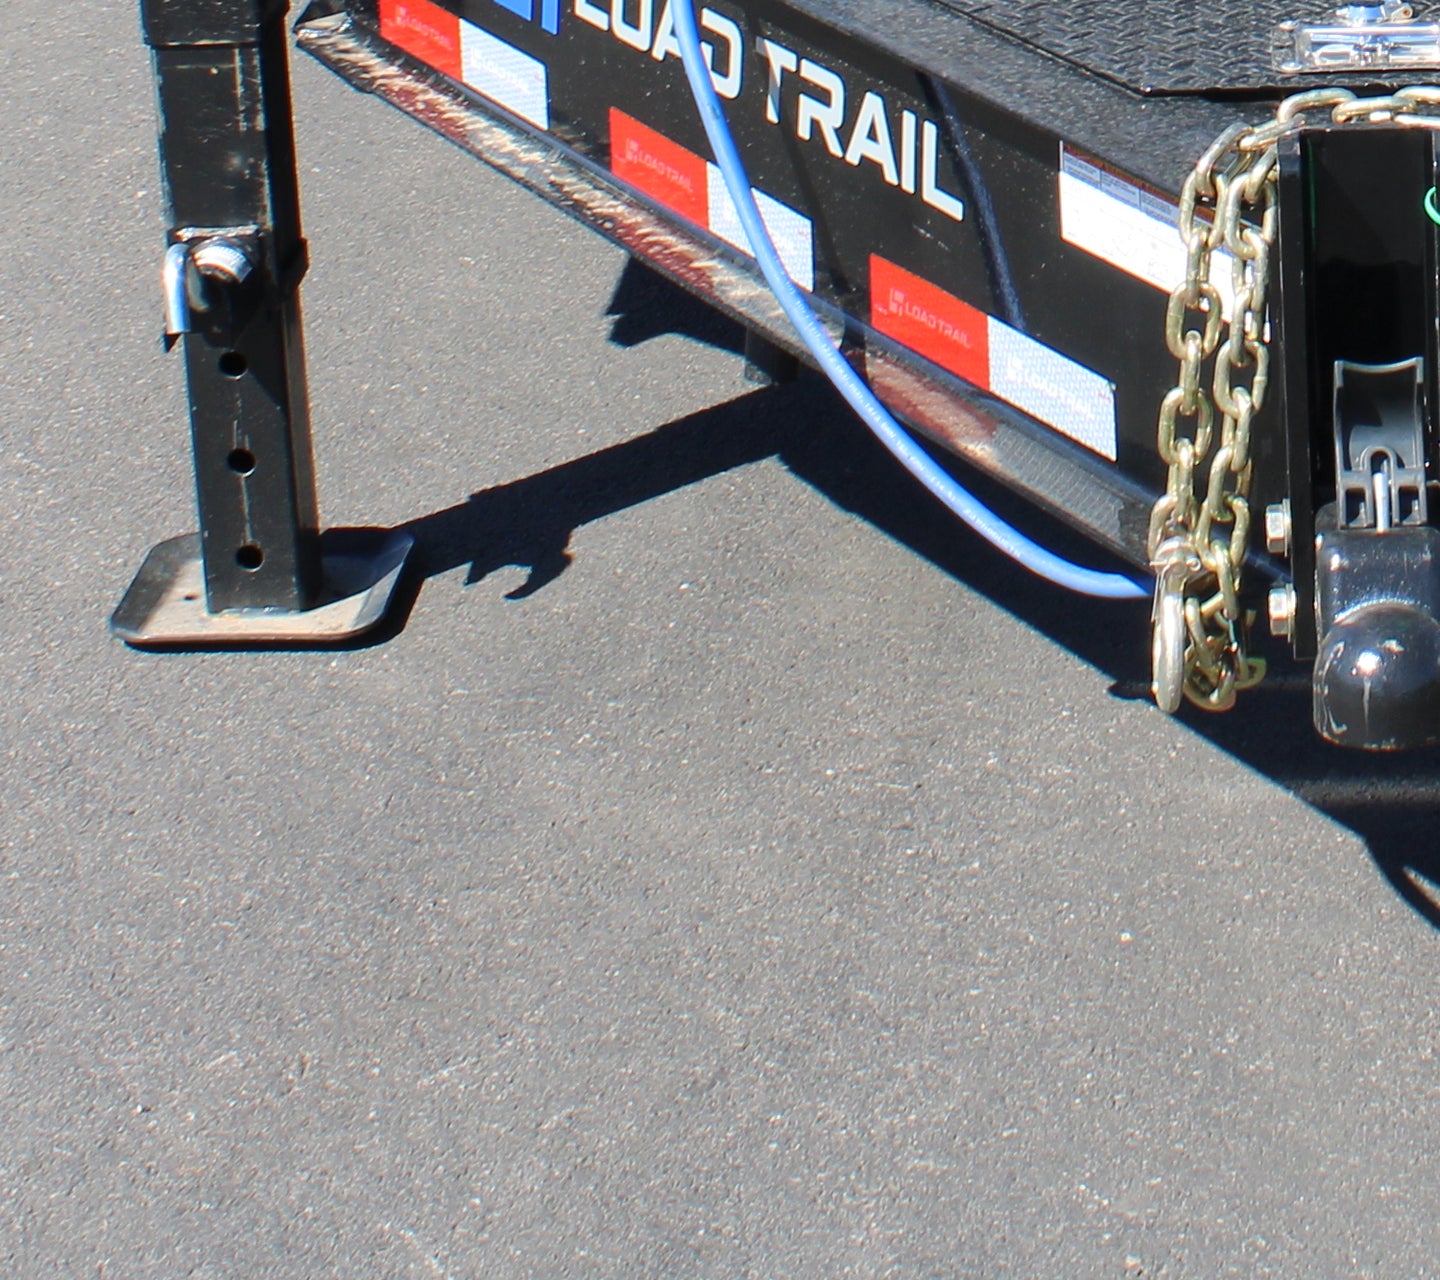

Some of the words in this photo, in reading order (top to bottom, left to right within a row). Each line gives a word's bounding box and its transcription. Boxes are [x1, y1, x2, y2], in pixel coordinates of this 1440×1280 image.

[758, 36, 965, 222] TRAIL
[904, 299, 937, 328] LOAD
[935, 315, 975, 350] TRAIL
